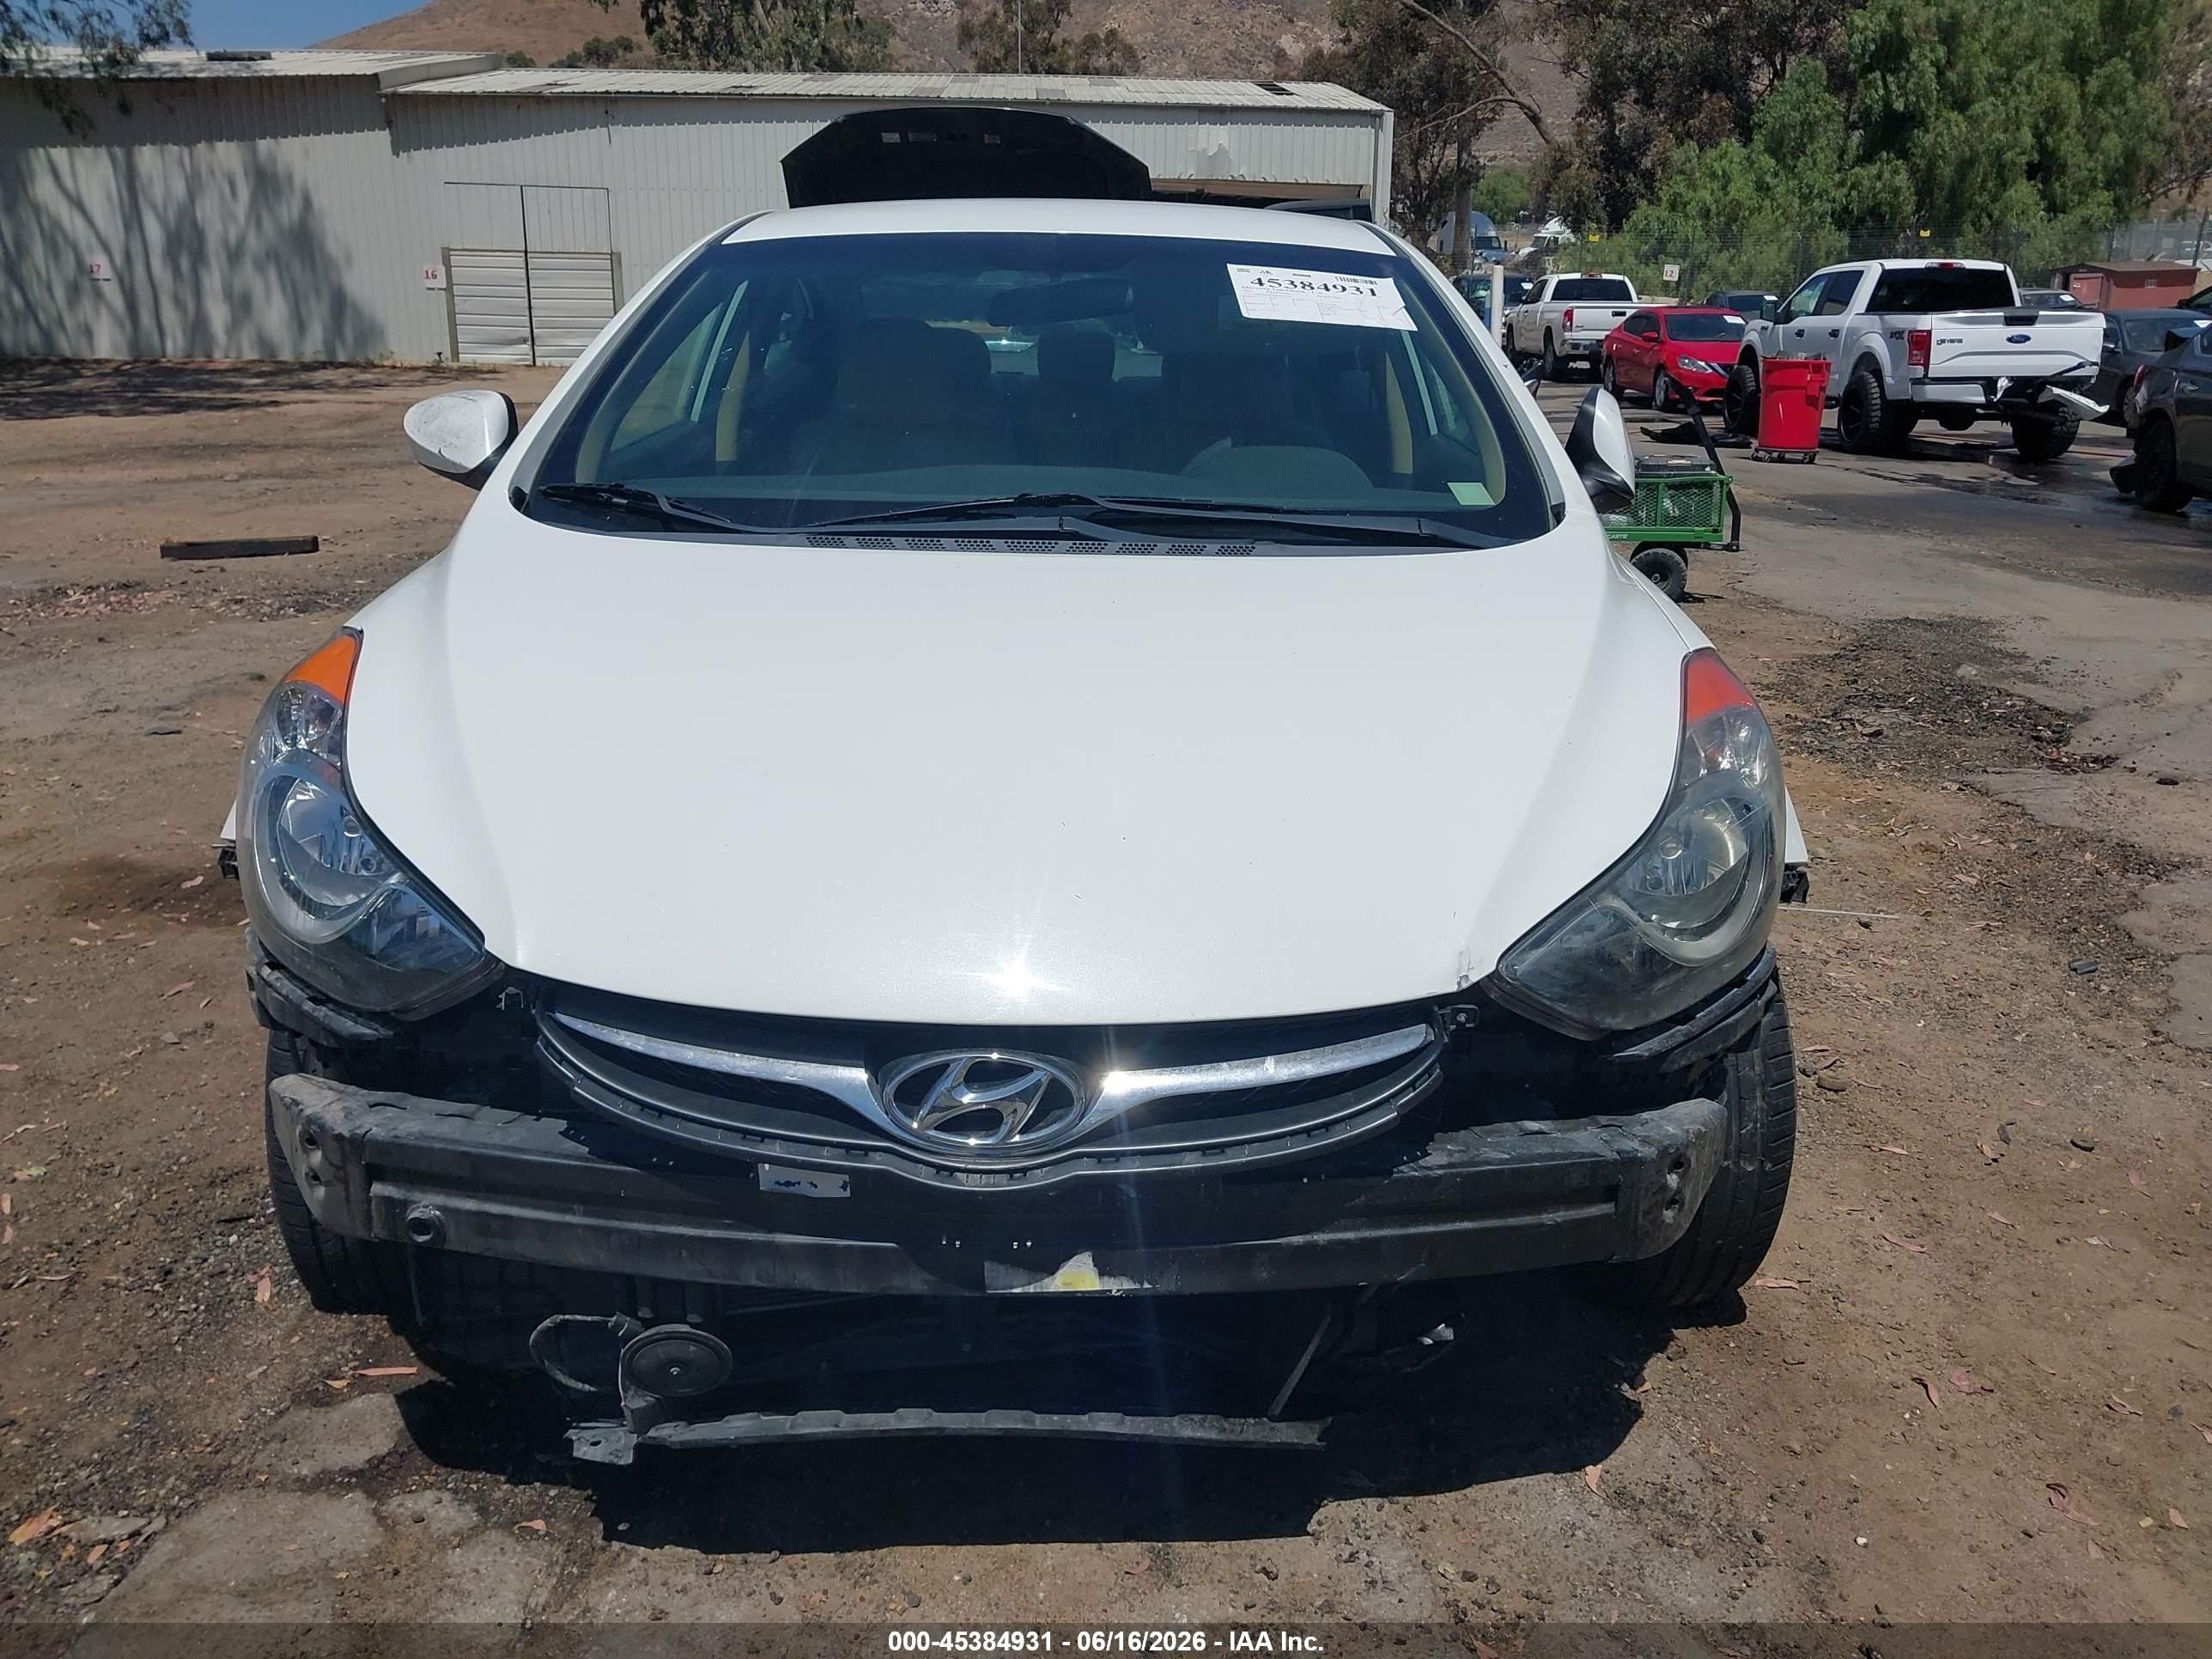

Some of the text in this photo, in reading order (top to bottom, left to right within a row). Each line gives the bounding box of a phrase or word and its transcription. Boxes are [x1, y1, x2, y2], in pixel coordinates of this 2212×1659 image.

[89, 264, 101, 274] 17
[425, 270, 438, 280] 16
[1250, 276, 1378, 297] 45384931
